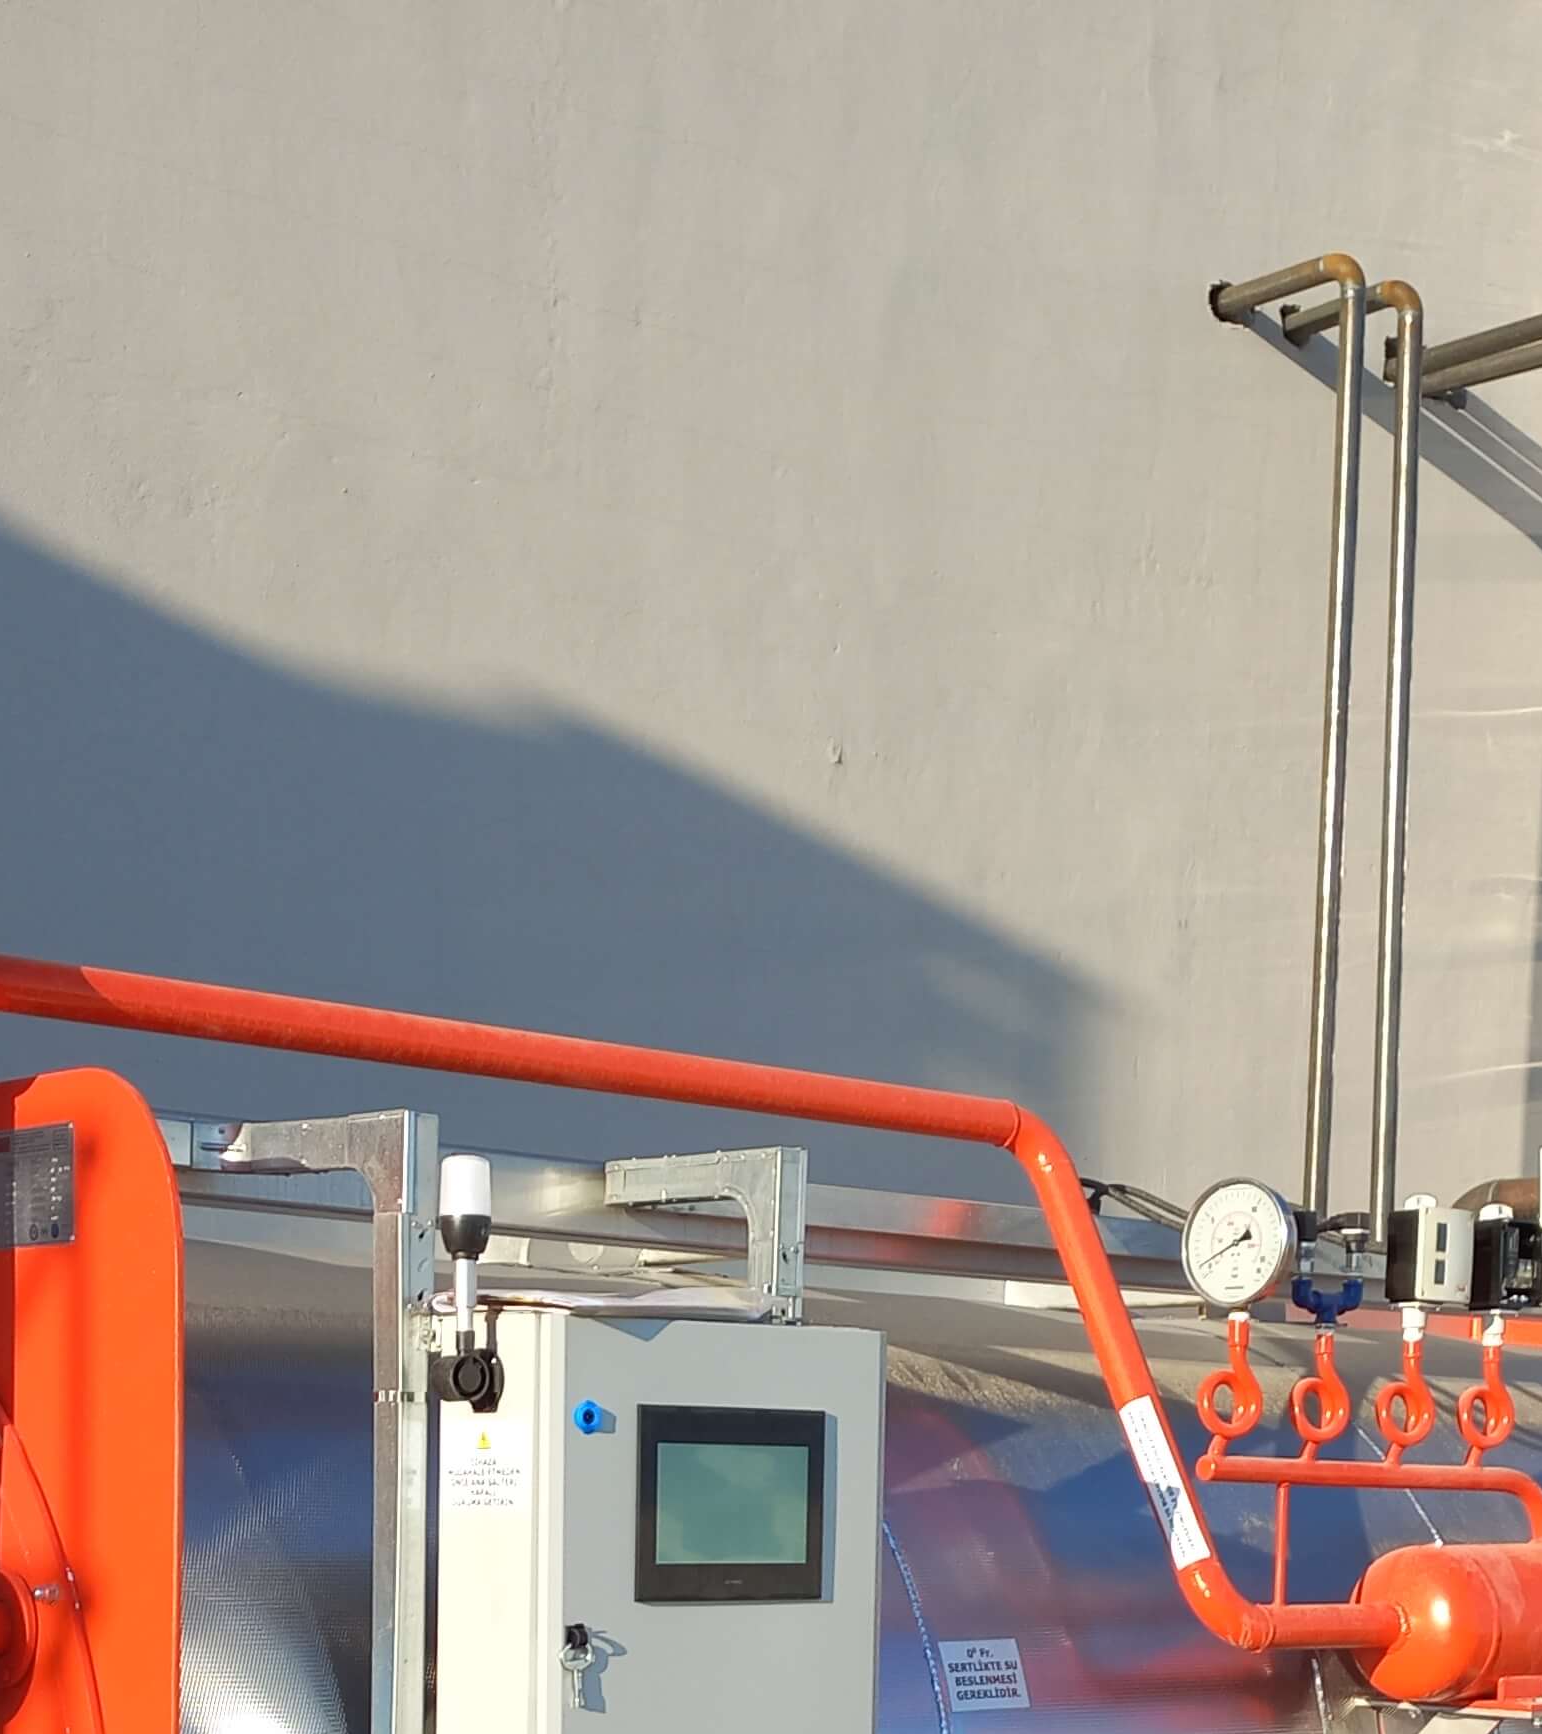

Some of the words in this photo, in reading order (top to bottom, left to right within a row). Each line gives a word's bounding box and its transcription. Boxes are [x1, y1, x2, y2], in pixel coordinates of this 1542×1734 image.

[947, 1659, 1003, 1673] SERTLİKTE
[1004, 1660, 1018, 1671] SU
[954, 1672, 1018, 1687] BESLENMESİ
